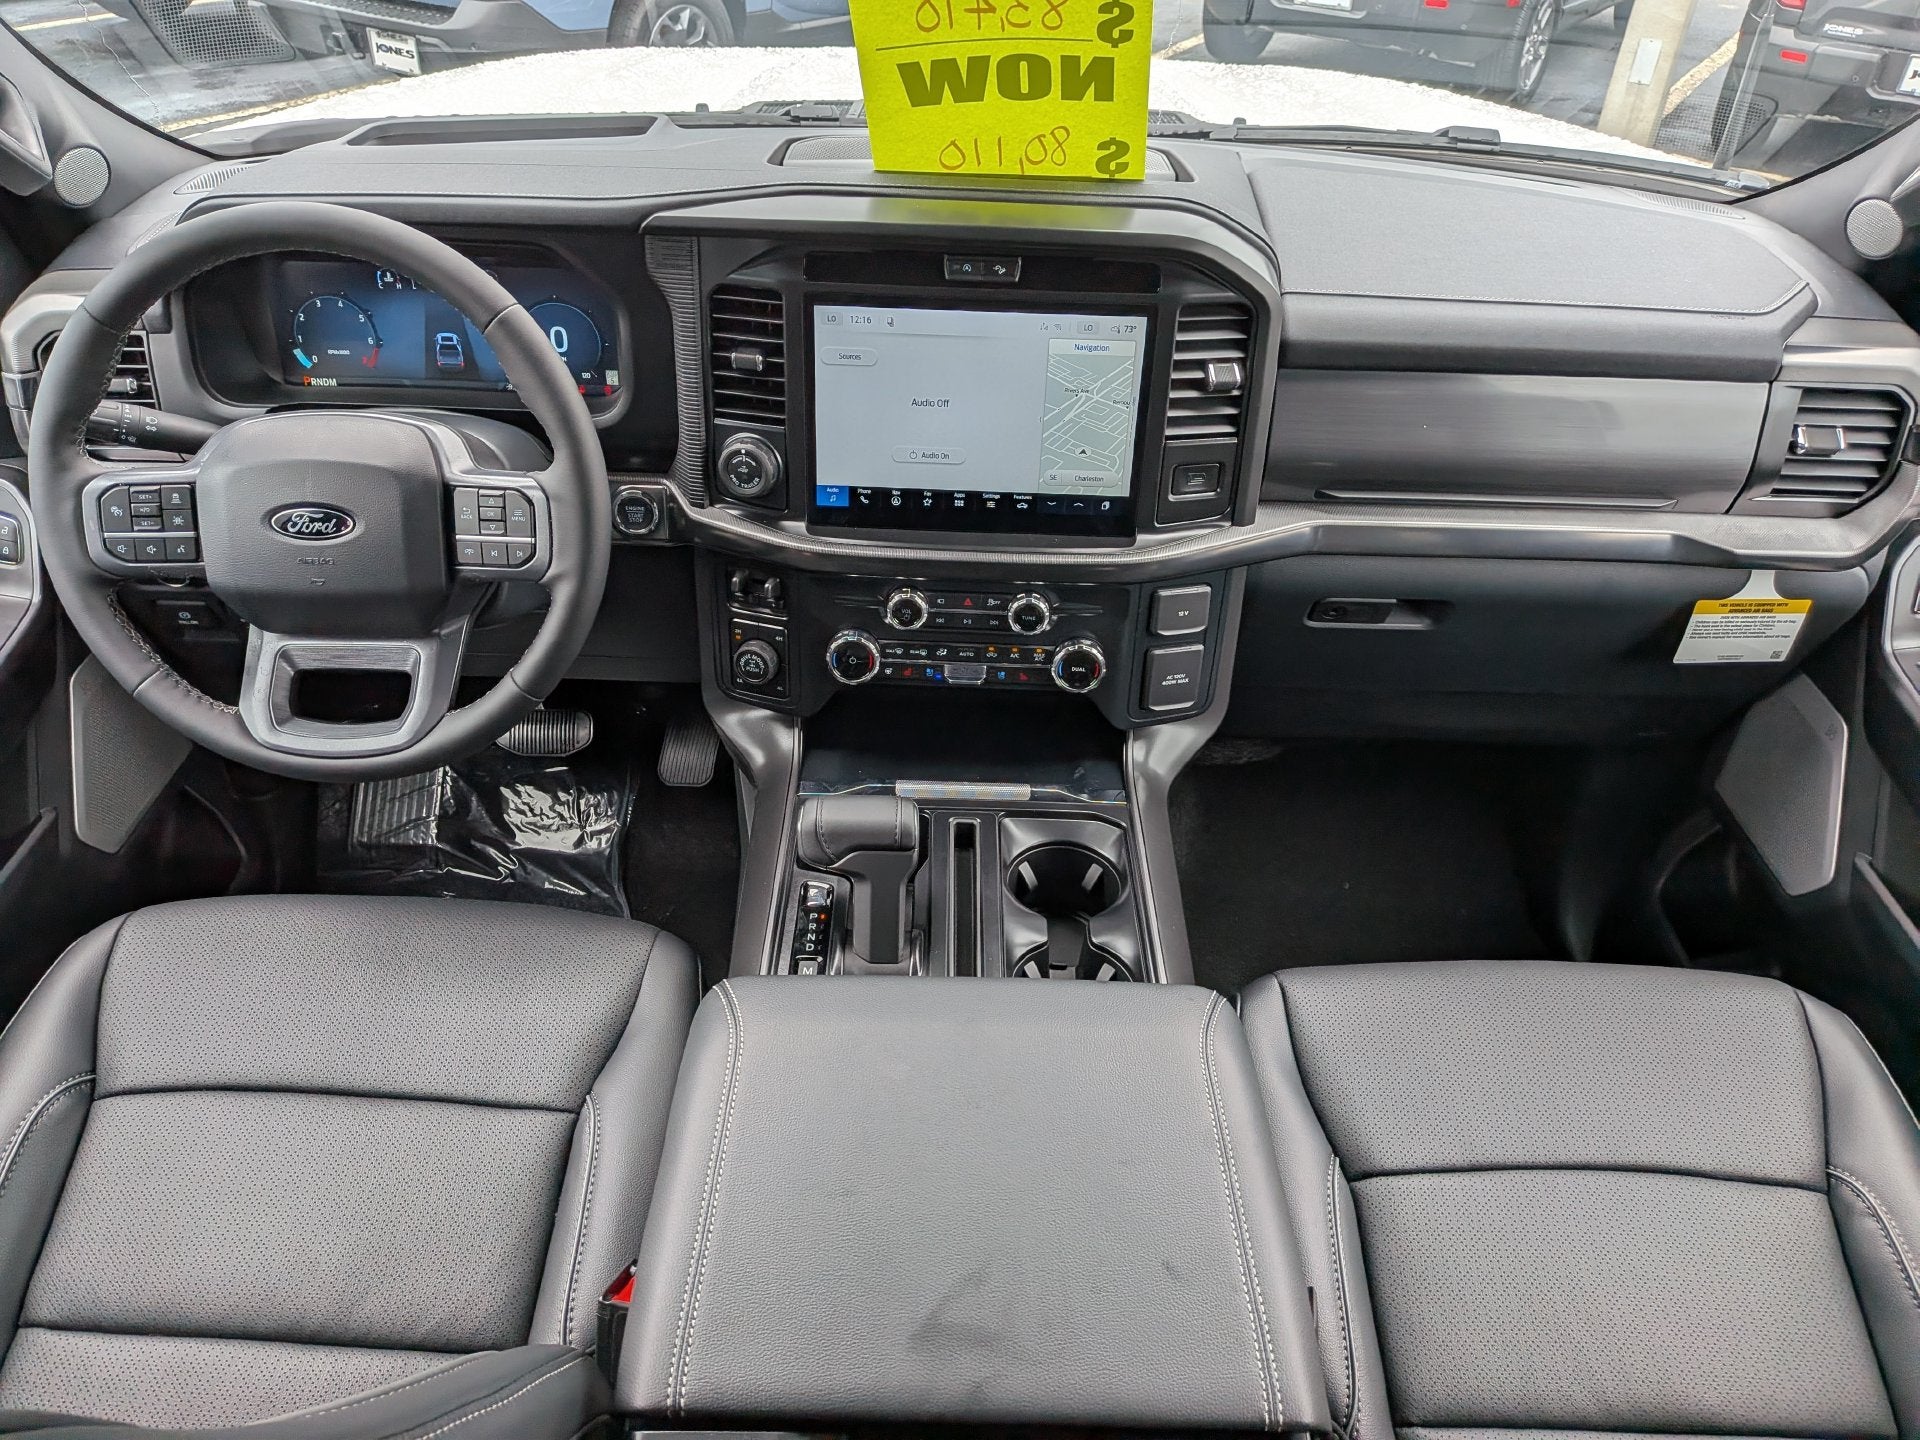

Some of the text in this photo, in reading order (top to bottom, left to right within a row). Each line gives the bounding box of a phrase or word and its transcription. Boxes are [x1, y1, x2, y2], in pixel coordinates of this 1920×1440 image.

[1823, 23, 1864, 35] JONES
[375, 42, 415, 59] JONES
[315, 300, 321, 308] 3
[338, 300, 343, 308] 4
[299, 313, 305, 321] 2
[827, 315, 837, 323] LO
[850, 315, 872, 324] 12:16
[1084, 324, 1093, 332] LO
[367, 337, 374, 345] 6
[549, 325, 569, 353] 0
[1074, 343, 1110, 353] Navigation
[312, 355, 318, 363] 0
[838, 352, 862, 361] Sources
[911, 398, 950, 408] Audio Off
[921, 451, 950, 460] Audio On
[1074, 475, 1104, 483] Charleston
[287, 511, 337, 534] Ford
[805, 943, 815, 951] D
